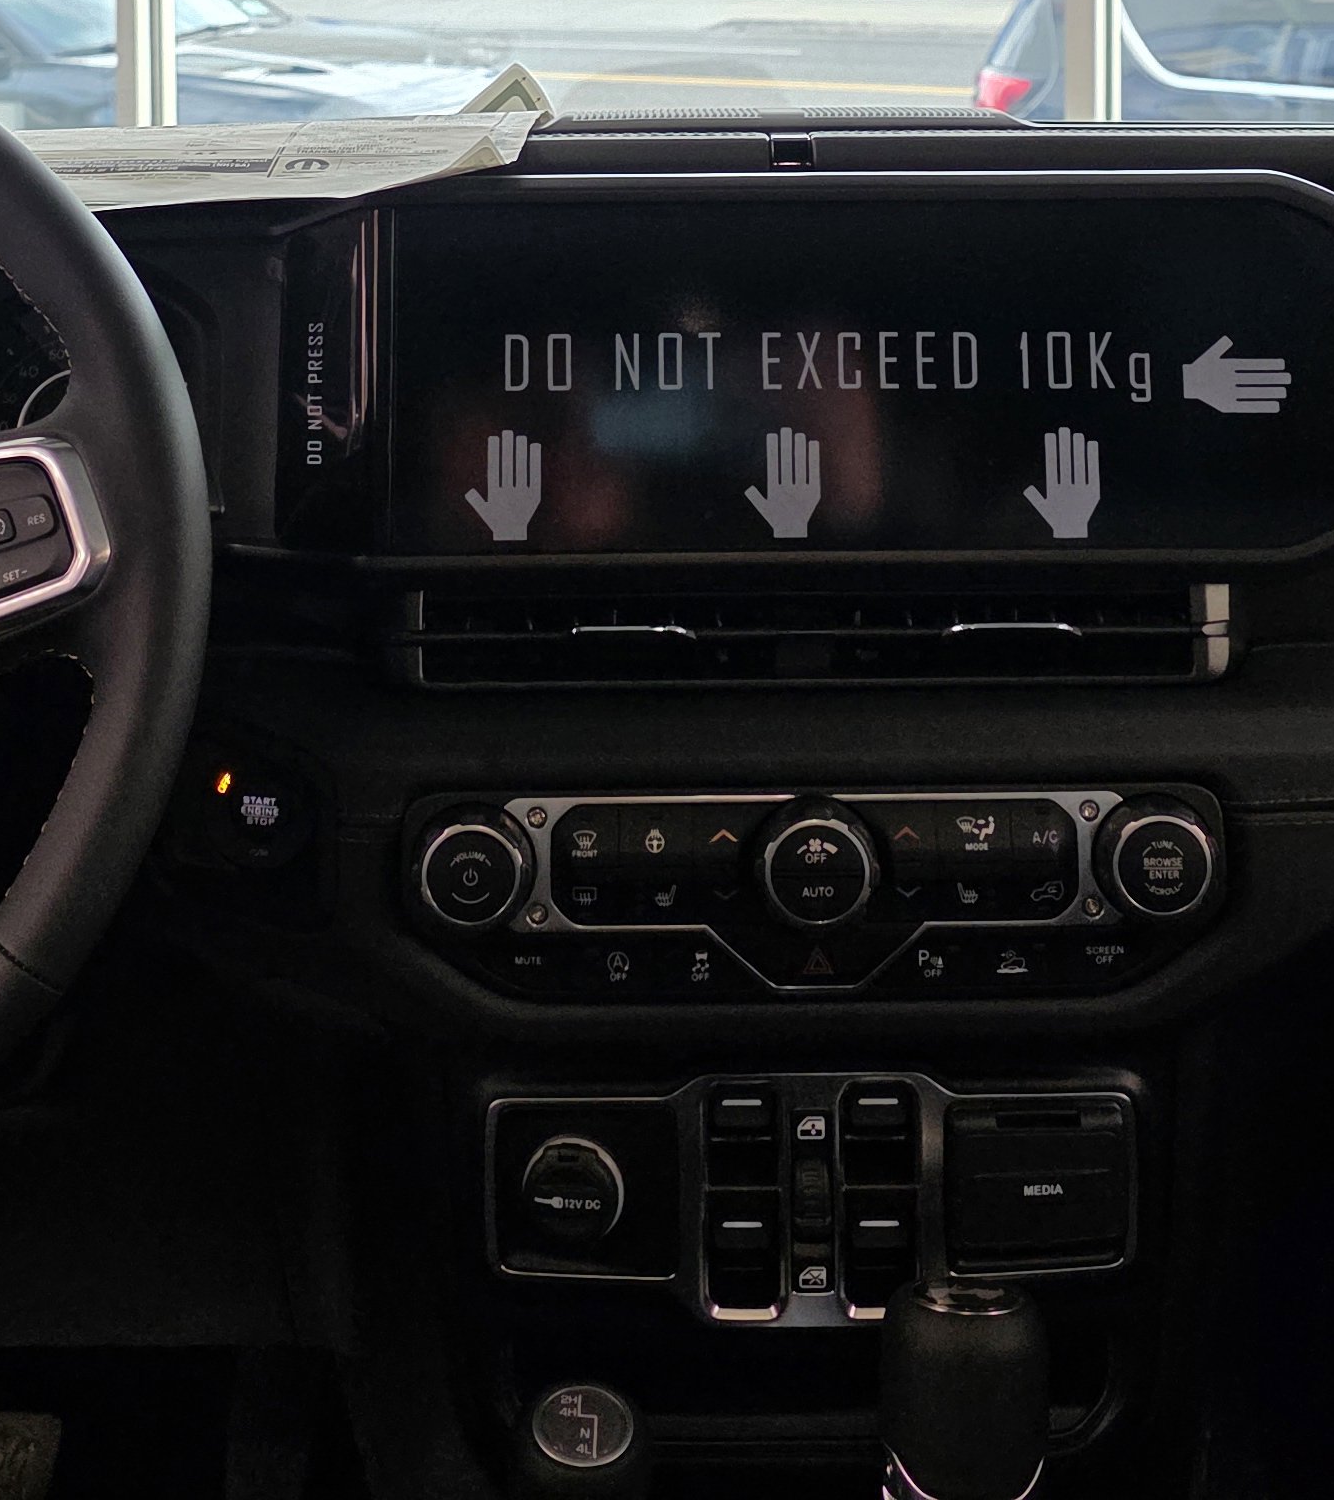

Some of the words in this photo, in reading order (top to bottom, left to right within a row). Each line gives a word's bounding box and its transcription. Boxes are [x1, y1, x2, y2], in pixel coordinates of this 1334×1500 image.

[307, 322, 324, 384] PRESS
[19, 364, 40, 379] 40
[504, 333, 571, 391] DO
[615, 333, 721, 391] NOT
[762, 331, 978, 391] EXCEED
[1019, 331, 1152, 402] 10Kg
[307, 393, 323, 430] NOT
[306, 440, 323, 465] DO
[26, 512, 47, 527] RES
[242, 795, 277, 806] START
[246, 816, 276, 827] STOP
[1032, 830, 1059, 844] A/C
[964, 842, 990, 851] MODE
[1150, 840, 1175, 851] TUNE
[454, 850, 488, 863] VOLUME
[571, 850, 598, 859] FRONT
[804, 852, 828, 865] OFF
[1142, 856, 1184, 868] BROWSE
[1148, 869, 1181, 880] ENTER
[801, 885, 835, 899] AUTO
[1147, 884, 1180, 897] SCROLL
[1085, 945, 1125, 955] SCREEN
[514, 955, 543, 966] MUTE
[1095, 955, 1114, 965] OFF
[609, 972, 628, 982] OFF
[690, 972, 710, 982] OFF
[923, 969, 943, 979] OFF
[1022, 1181, 1064, 1197] MEDIA
[564, 1198, 583, 1211] 12V
[585, 1198, 602, 1211] DC
[560, 1394, 578, 1405] 2H
[559, 1407, 577, 1417] 4H
[579, 1427, 591, 1439] N
[575, 1443, 592, 1455] 4L
